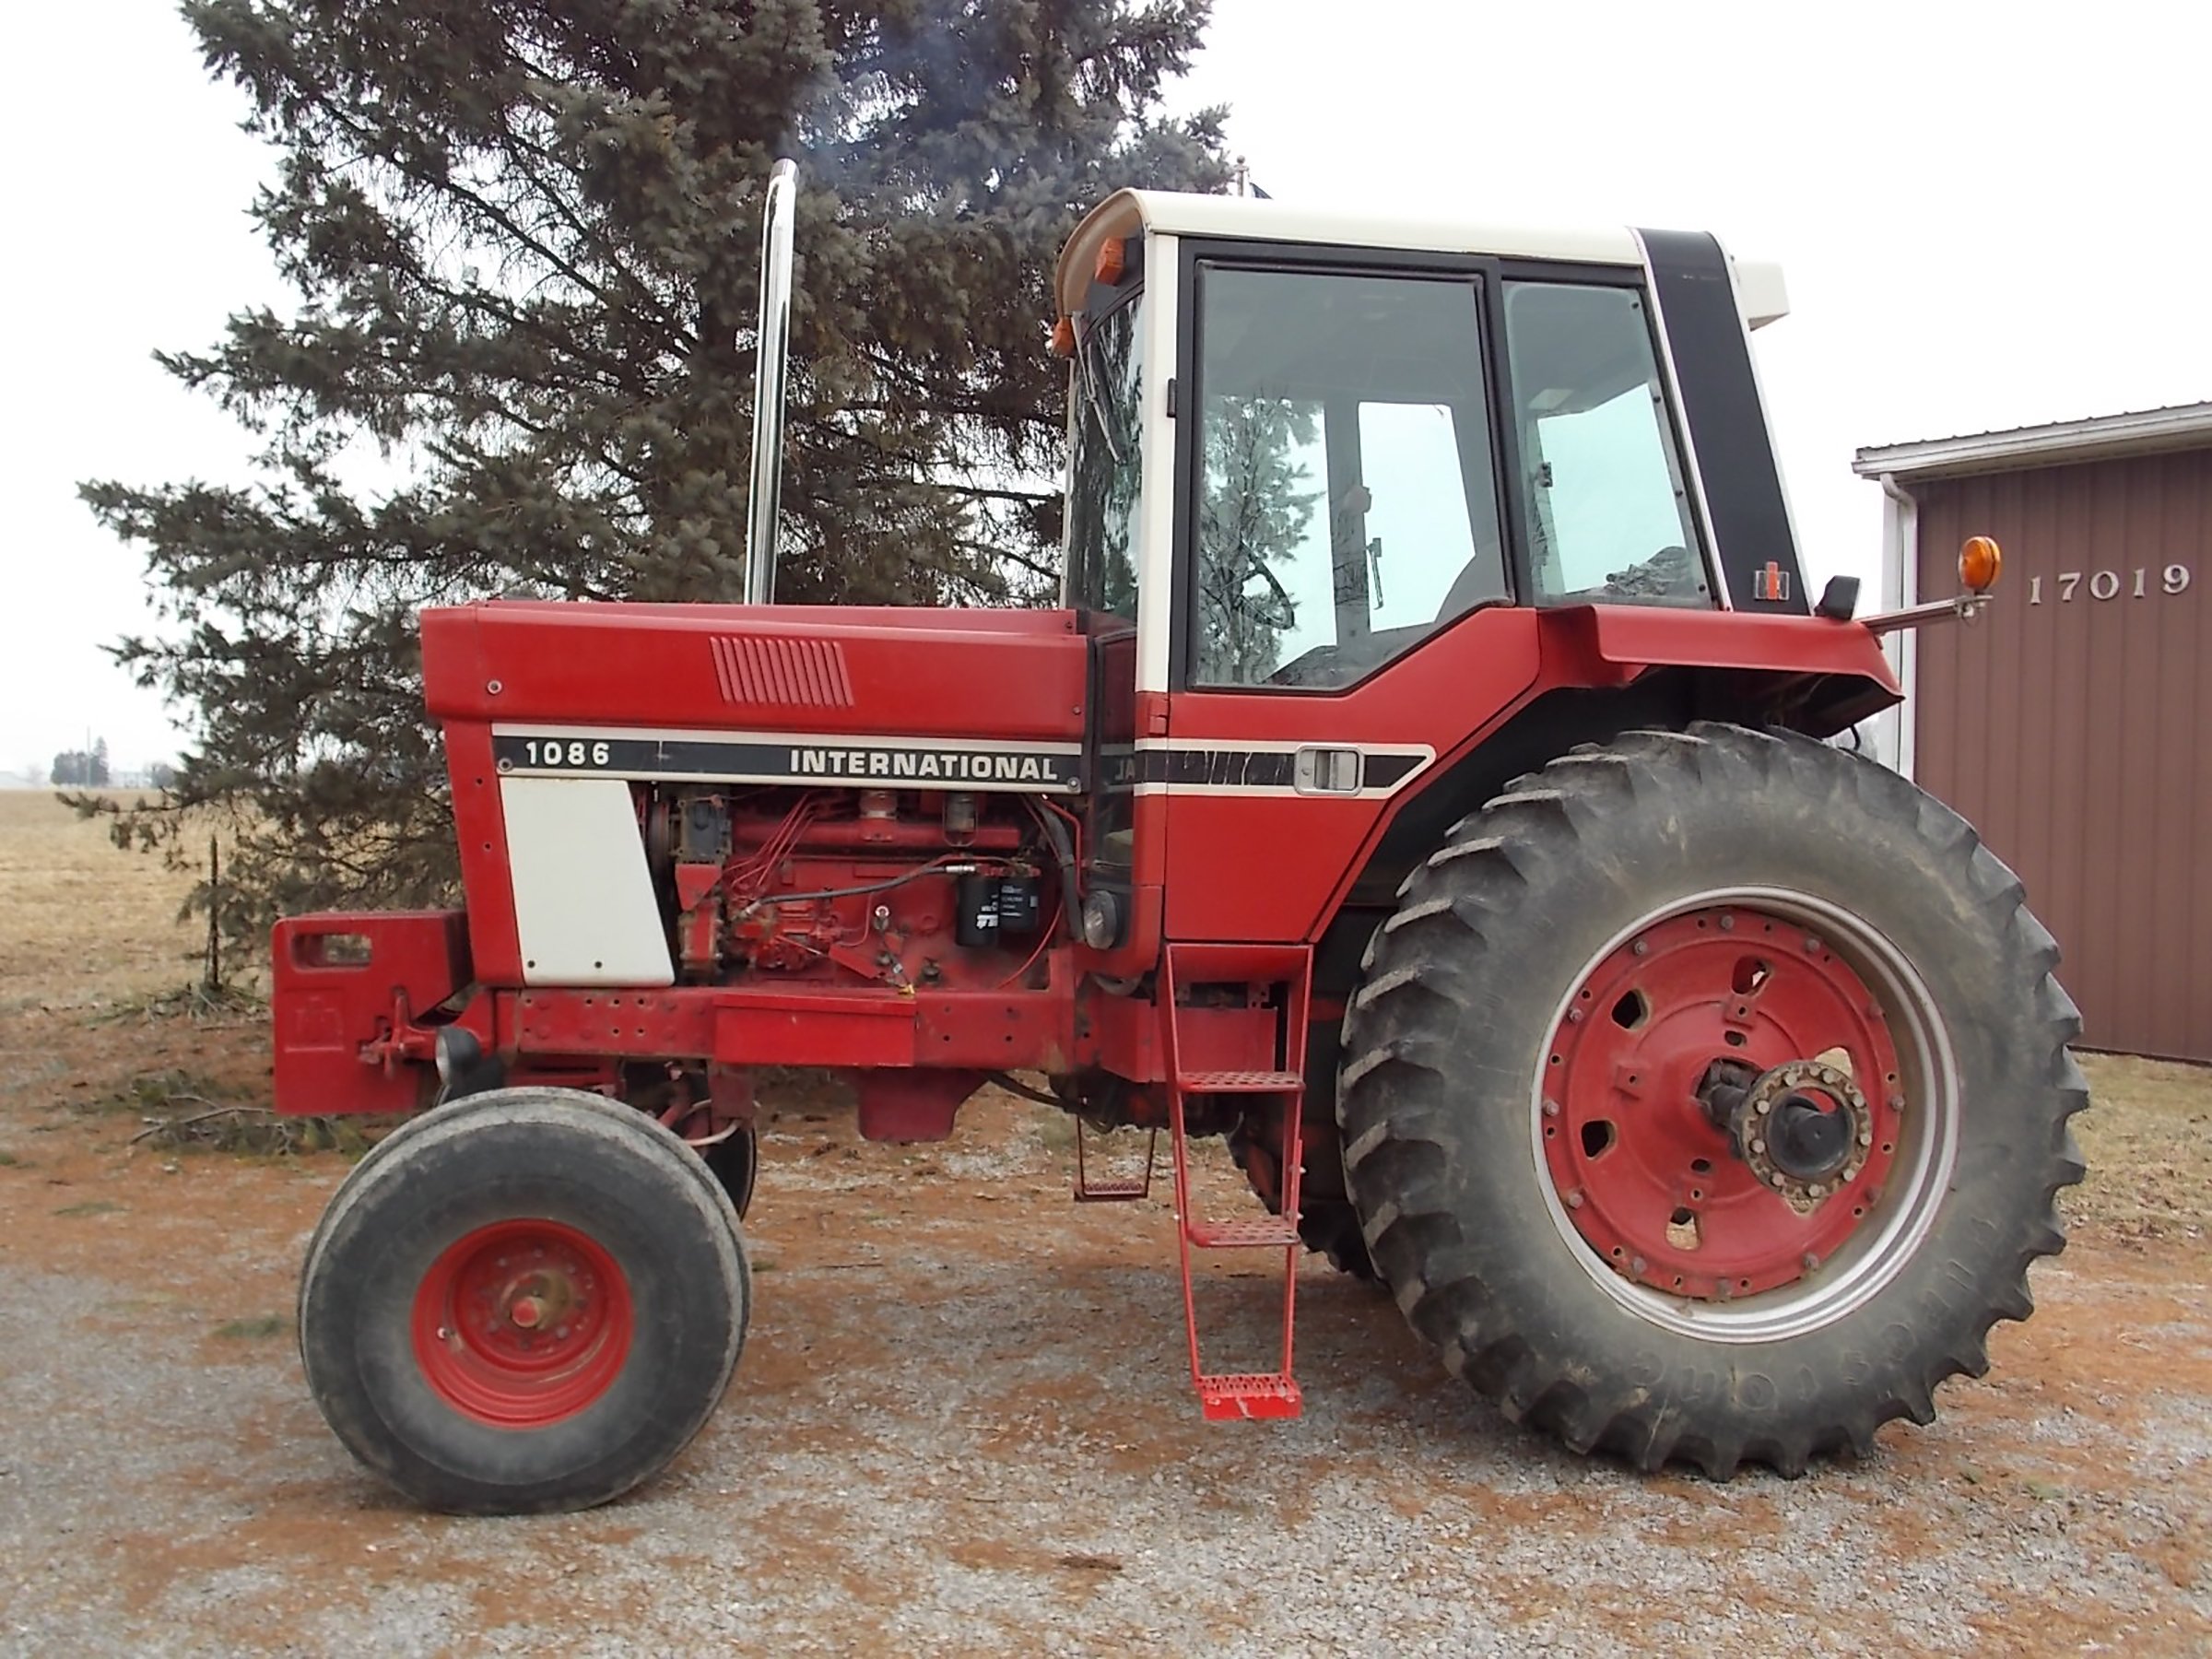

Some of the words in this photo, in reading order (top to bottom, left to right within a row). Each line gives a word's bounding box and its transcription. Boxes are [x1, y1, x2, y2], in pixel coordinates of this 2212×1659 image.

[2030, 564, 2191, 605] 17019
[525, 741, 610, 766] 1086
[790, 749, 1058, 781] INTERNATIONAL
